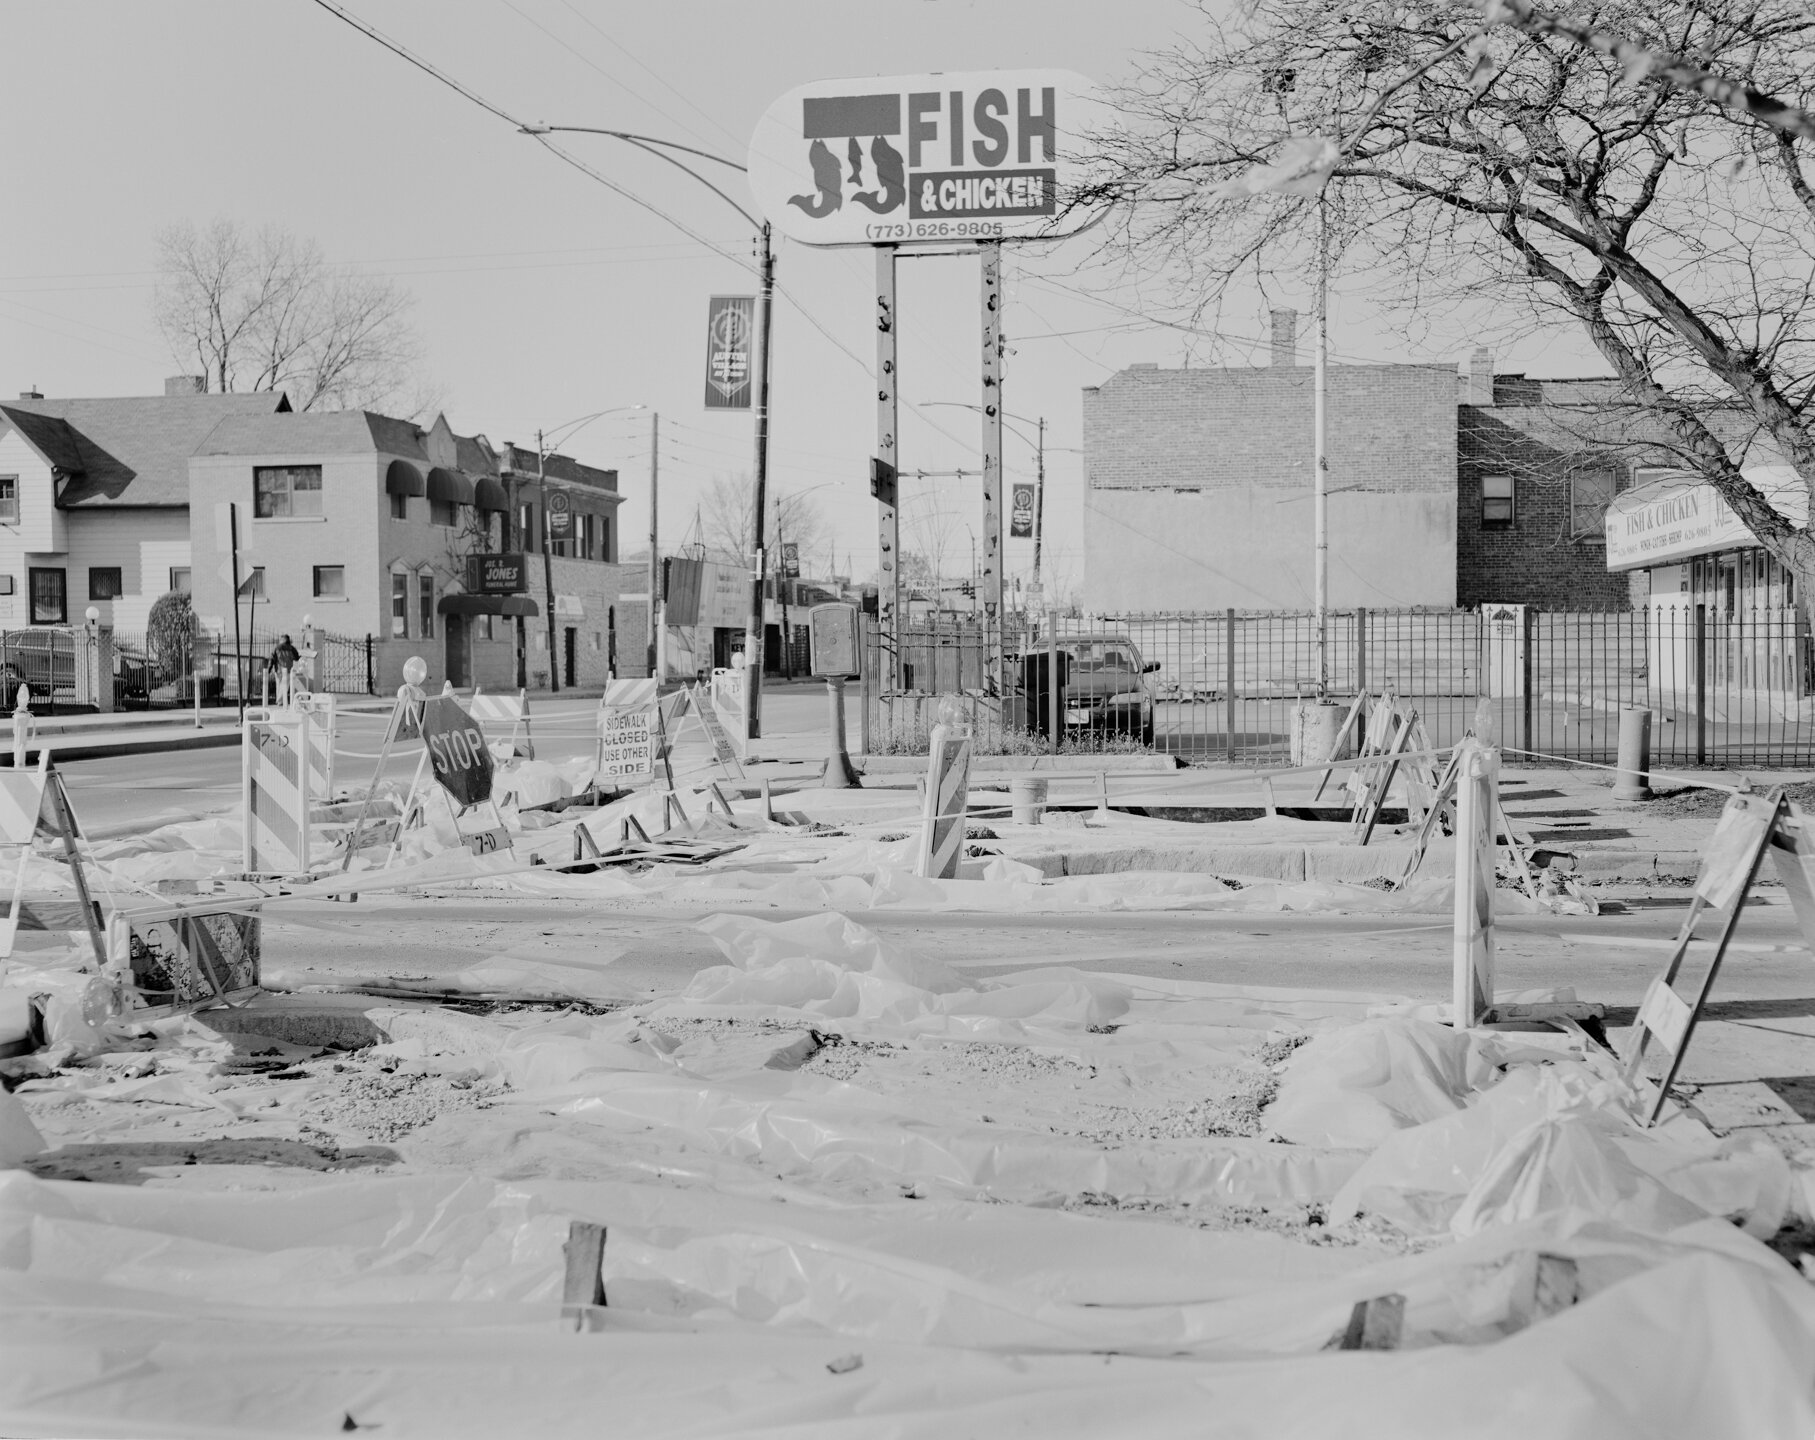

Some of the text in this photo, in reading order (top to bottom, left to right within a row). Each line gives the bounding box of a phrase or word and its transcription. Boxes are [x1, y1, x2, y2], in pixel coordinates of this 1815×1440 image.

[908, 87, 1056, 168] FISH
[920, 175, 1044, 212] & CHICKEN
[1626, 493, 1699, 537] FISH & CHICKEN
[486, 567, 518, 580] JONES
[606, 714, 646, 730] SIDEWALK
[605, 730, 648, 746] CLOSED
[429, 728, 482, 774] STOP
[605, 746, 648, 762] USE OTHER
[609, 763, 645, 775] SIDE
